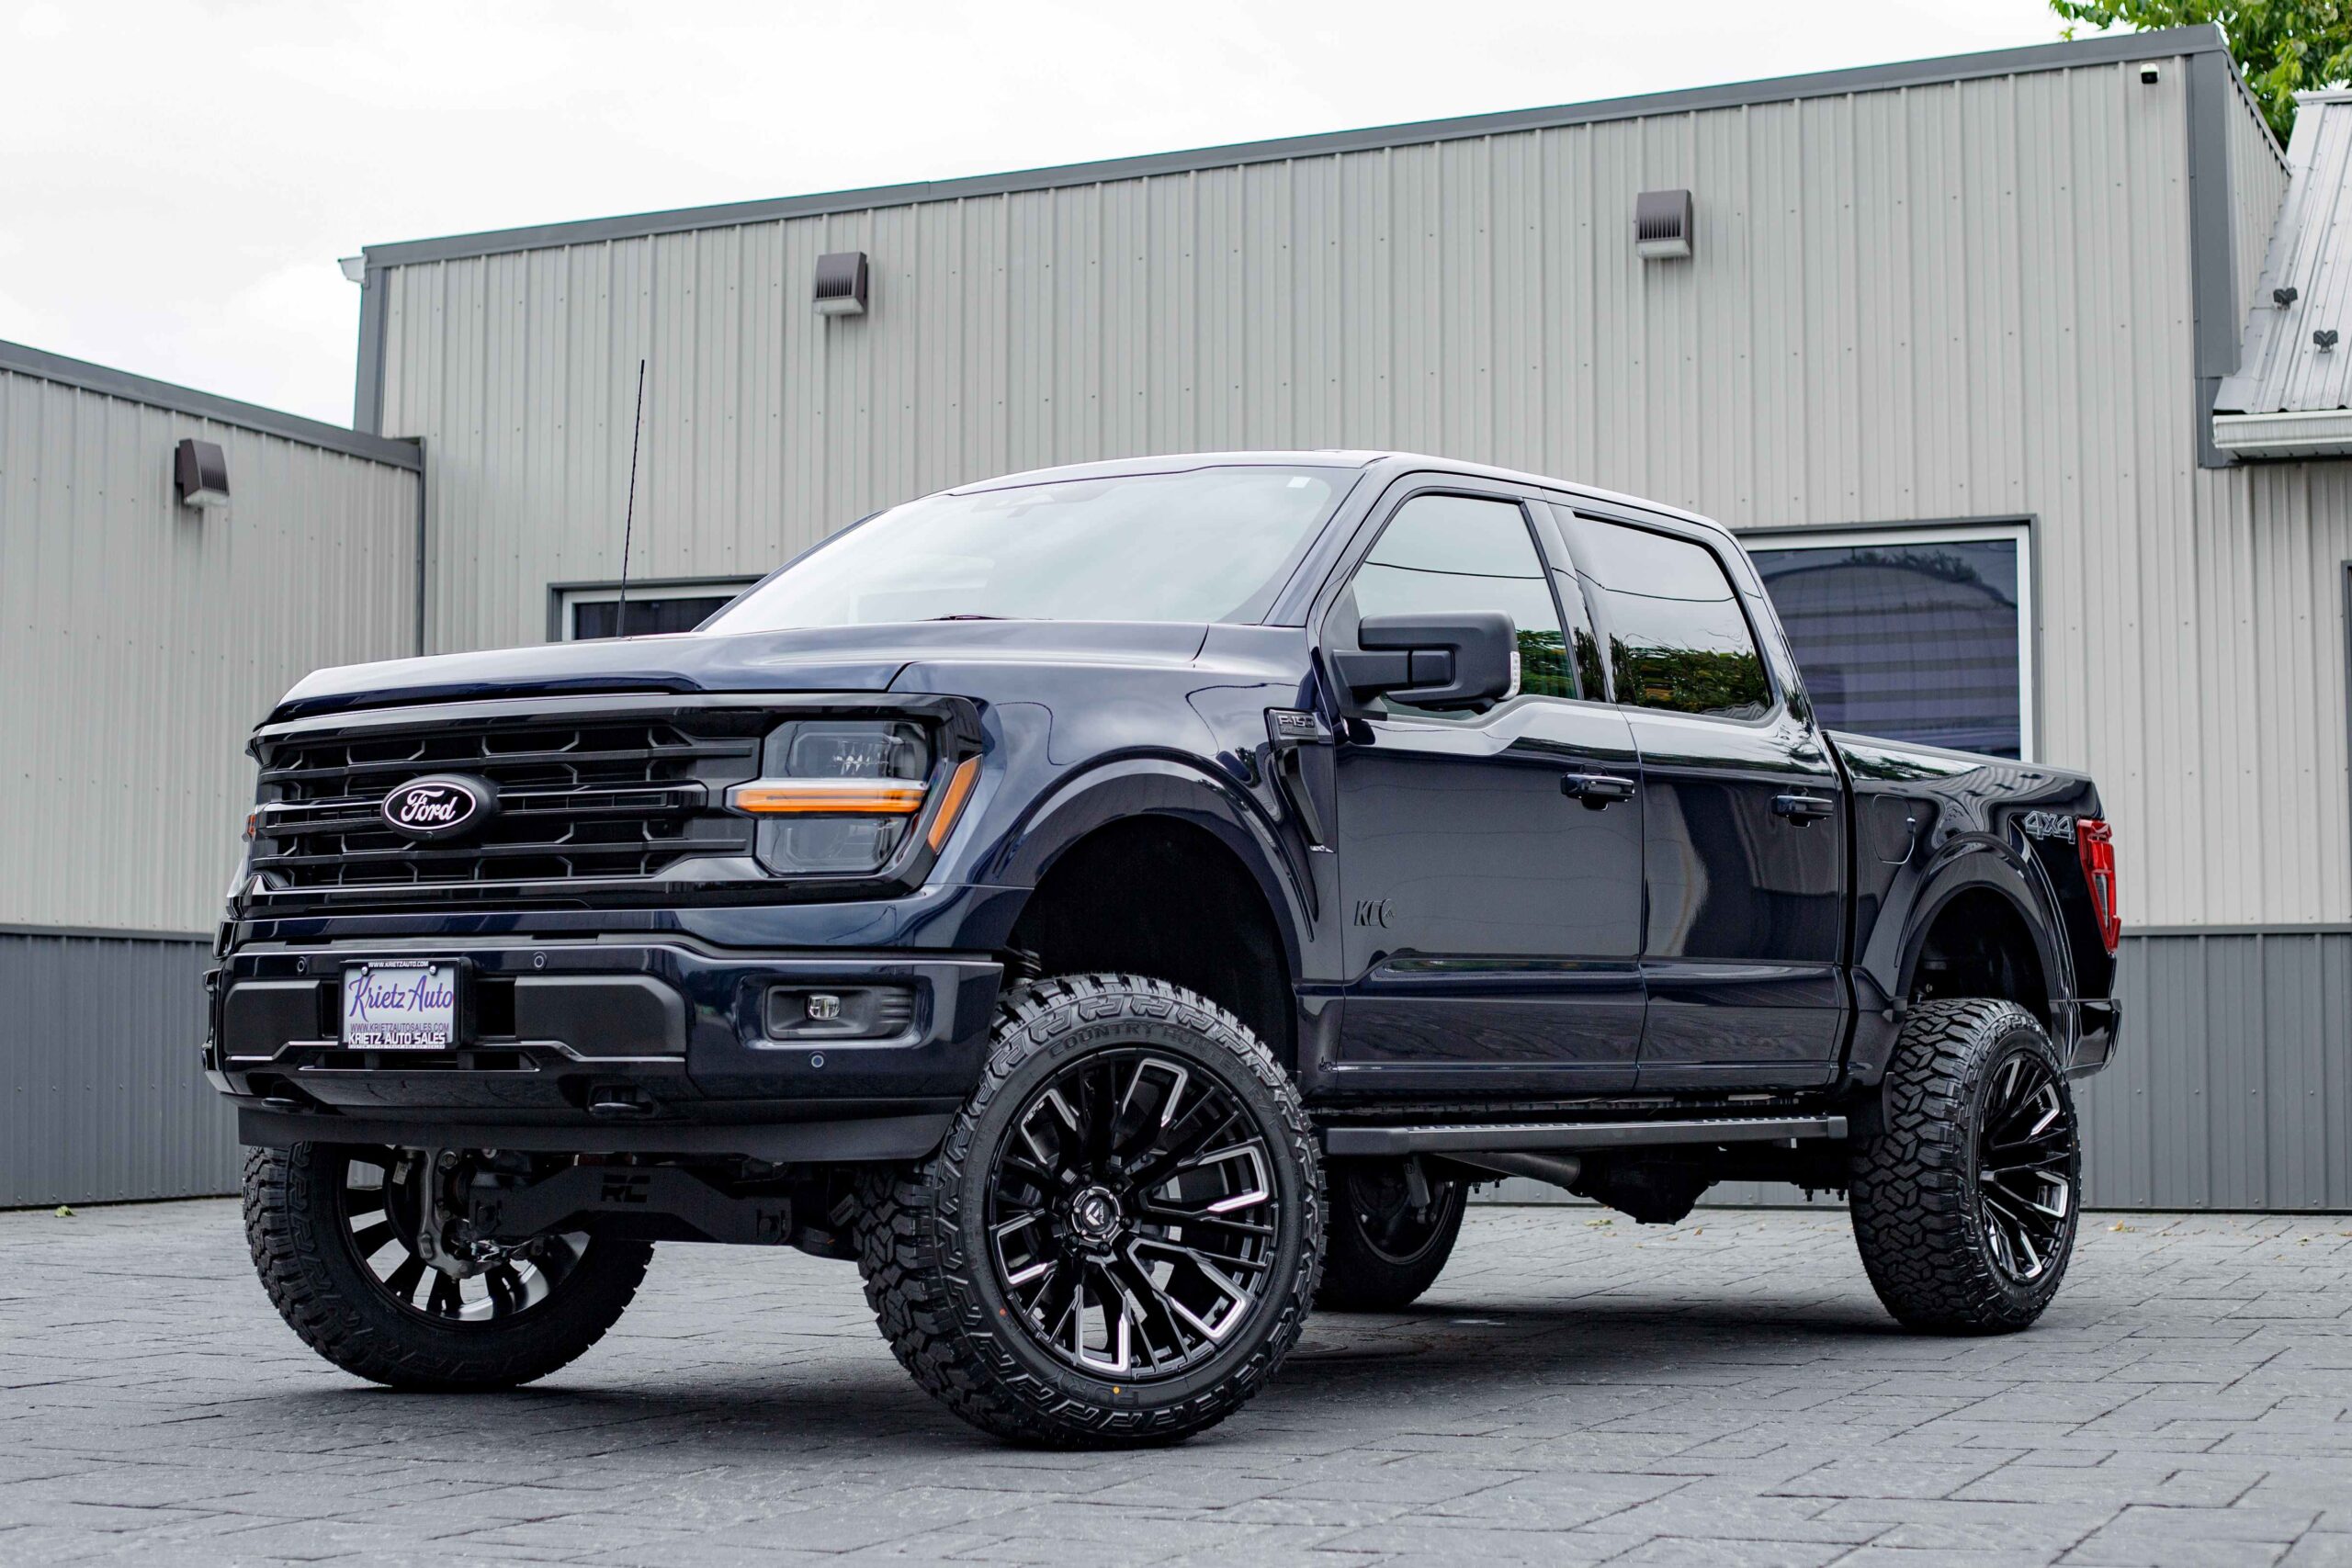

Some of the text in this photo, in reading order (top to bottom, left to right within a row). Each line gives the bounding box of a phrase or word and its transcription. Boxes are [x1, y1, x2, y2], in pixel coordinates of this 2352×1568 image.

[1277, 715, 1315, 728] F-150
[401, 790, 458, 822] Ford
[348, 974, 454, 1022] Krietz Auto
[349, 1032, 445, 1044] KRIETZ AUTO SALES
[351, 1022, 449, 1032] WWW.KRIETZAUTOSALES.COM
[1047, 1021, 1155, 1059] COUNTRY
[1162, 1024, 1248, 1084] HUNTER
[1042, 1370, 1139, 1408] FURY
